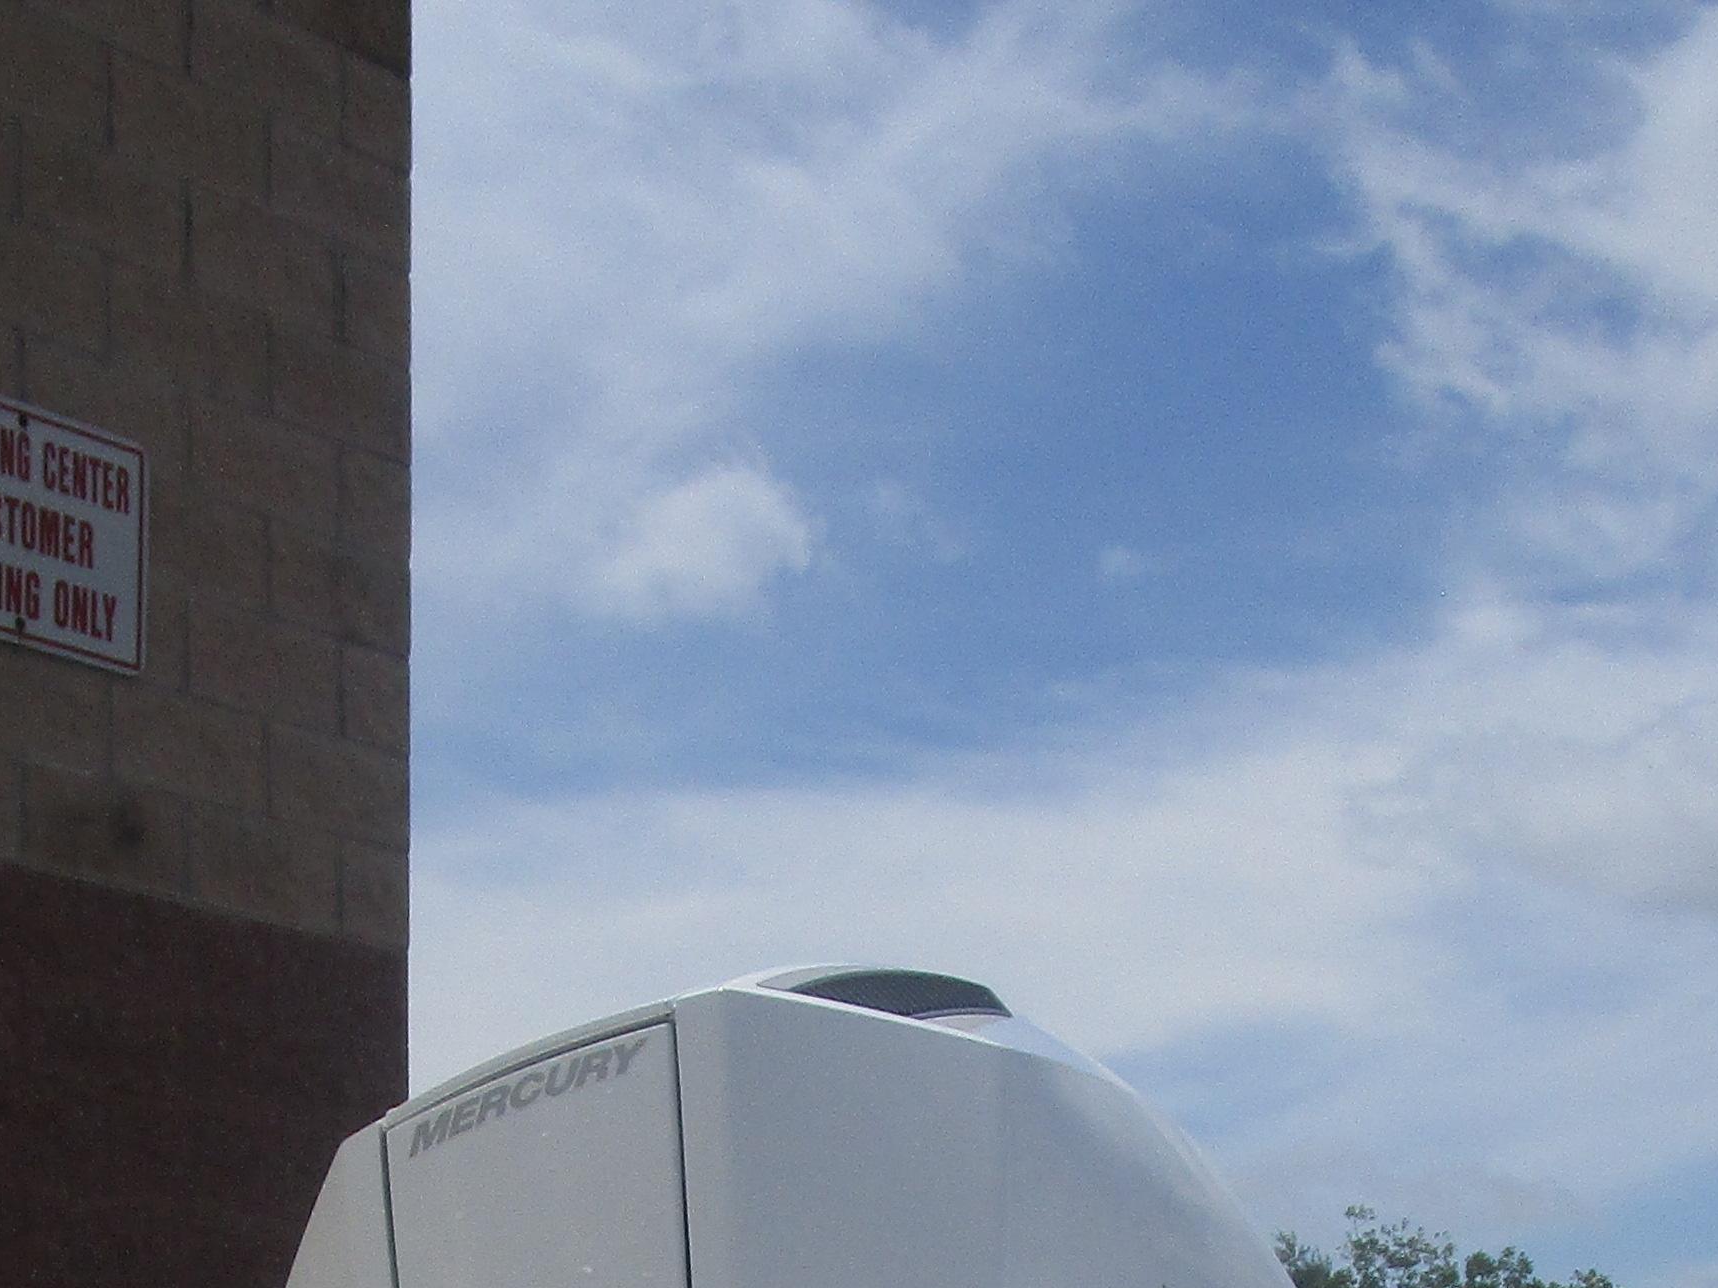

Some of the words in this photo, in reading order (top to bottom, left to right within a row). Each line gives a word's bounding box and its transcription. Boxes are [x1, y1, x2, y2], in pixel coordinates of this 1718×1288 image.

[42, 442, 130, 515] CENTER
[54, 579, 117, 642] ONLY
[409, 1037, 649, 1158] MERCURY
